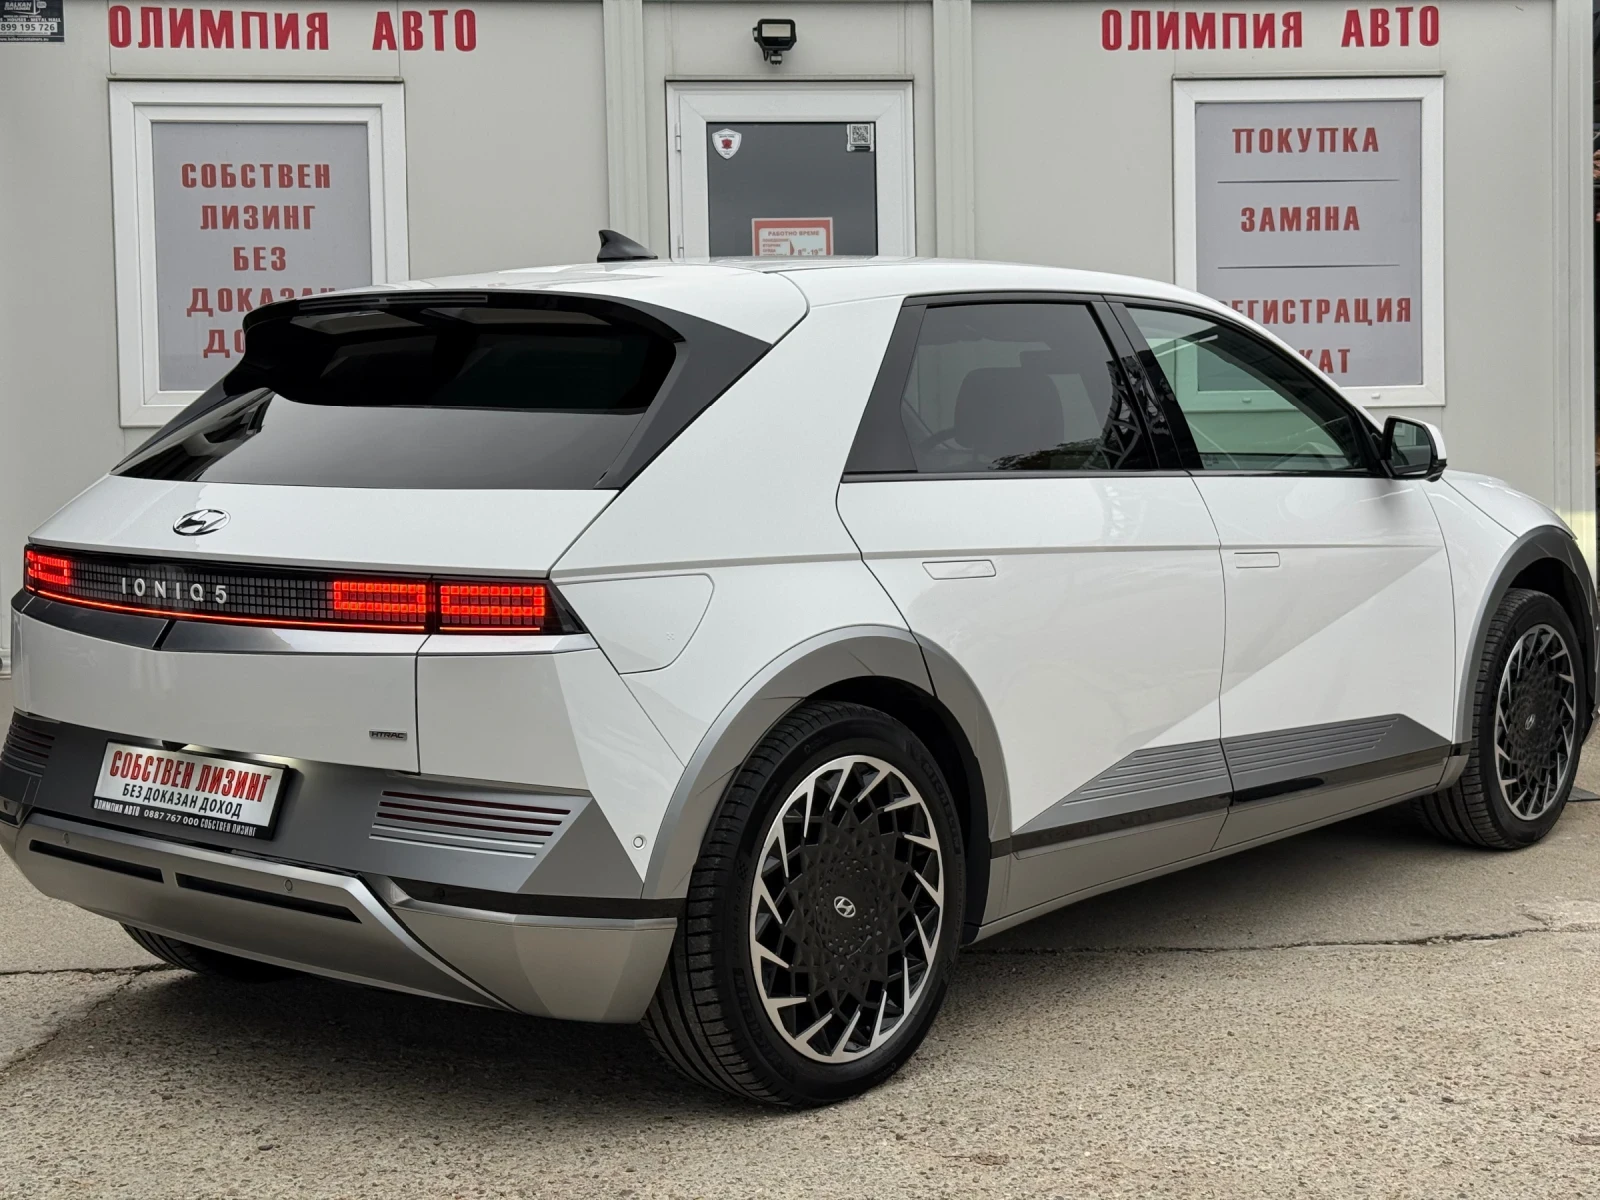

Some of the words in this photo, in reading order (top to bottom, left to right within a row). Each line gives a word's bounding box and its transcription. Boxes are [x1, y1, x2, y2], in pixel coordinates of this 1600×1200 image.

[20, 23, 36, 31] 195
[39, 23, 55, 31] 726
[108, 5, 329, 50] ОЛИМПИЯ
[372, 9, 477, 52] АВТО
[1101, 9, 1303, 51] ОЛИМПИЯ
[1341, 5, 1440, 48] АВТО
[1233, 127, 1379, 153] ПОКУПКА
[181, 164, 330, 189] СОБСТВЕН
[201, 205, 315, 229] ЛИЗИНГ
[1241, 206, 1359, 231] ЗАМЯНА
[233, 247, 286, 271] БЕЗ
[187, 288, 336, 317] ДОКА
[1222, 298, 1411, 325] ЕГИСТРАЦИЯ
[122, 577, 204, 602] IONIQ
[215, 585, 227, 604] 5
[371, 731, 404, 739] HTRAC
[109, 750, 195, 789] СОБСТВЕН
[195, 765, 272, 802] ЛИЗИНГ
[122, 783, 143, 799] БЕЗ
[143, 787, 199, 809] ДОКАЗАН
[198, 797, 243, 820] ДОХОД
[93, 799, 123, 814] ОЛИМПИЯ
[123, 804, 140, 817] АВТО
[143, 809, 165, 820] 0887
[166, 813, 181, 823] 767
[182, 816, 199, 827] 000
[200, 818, 231, 832] СОБСТВЕН
[231, 824, 257, 837] ЛИЗИНГ
